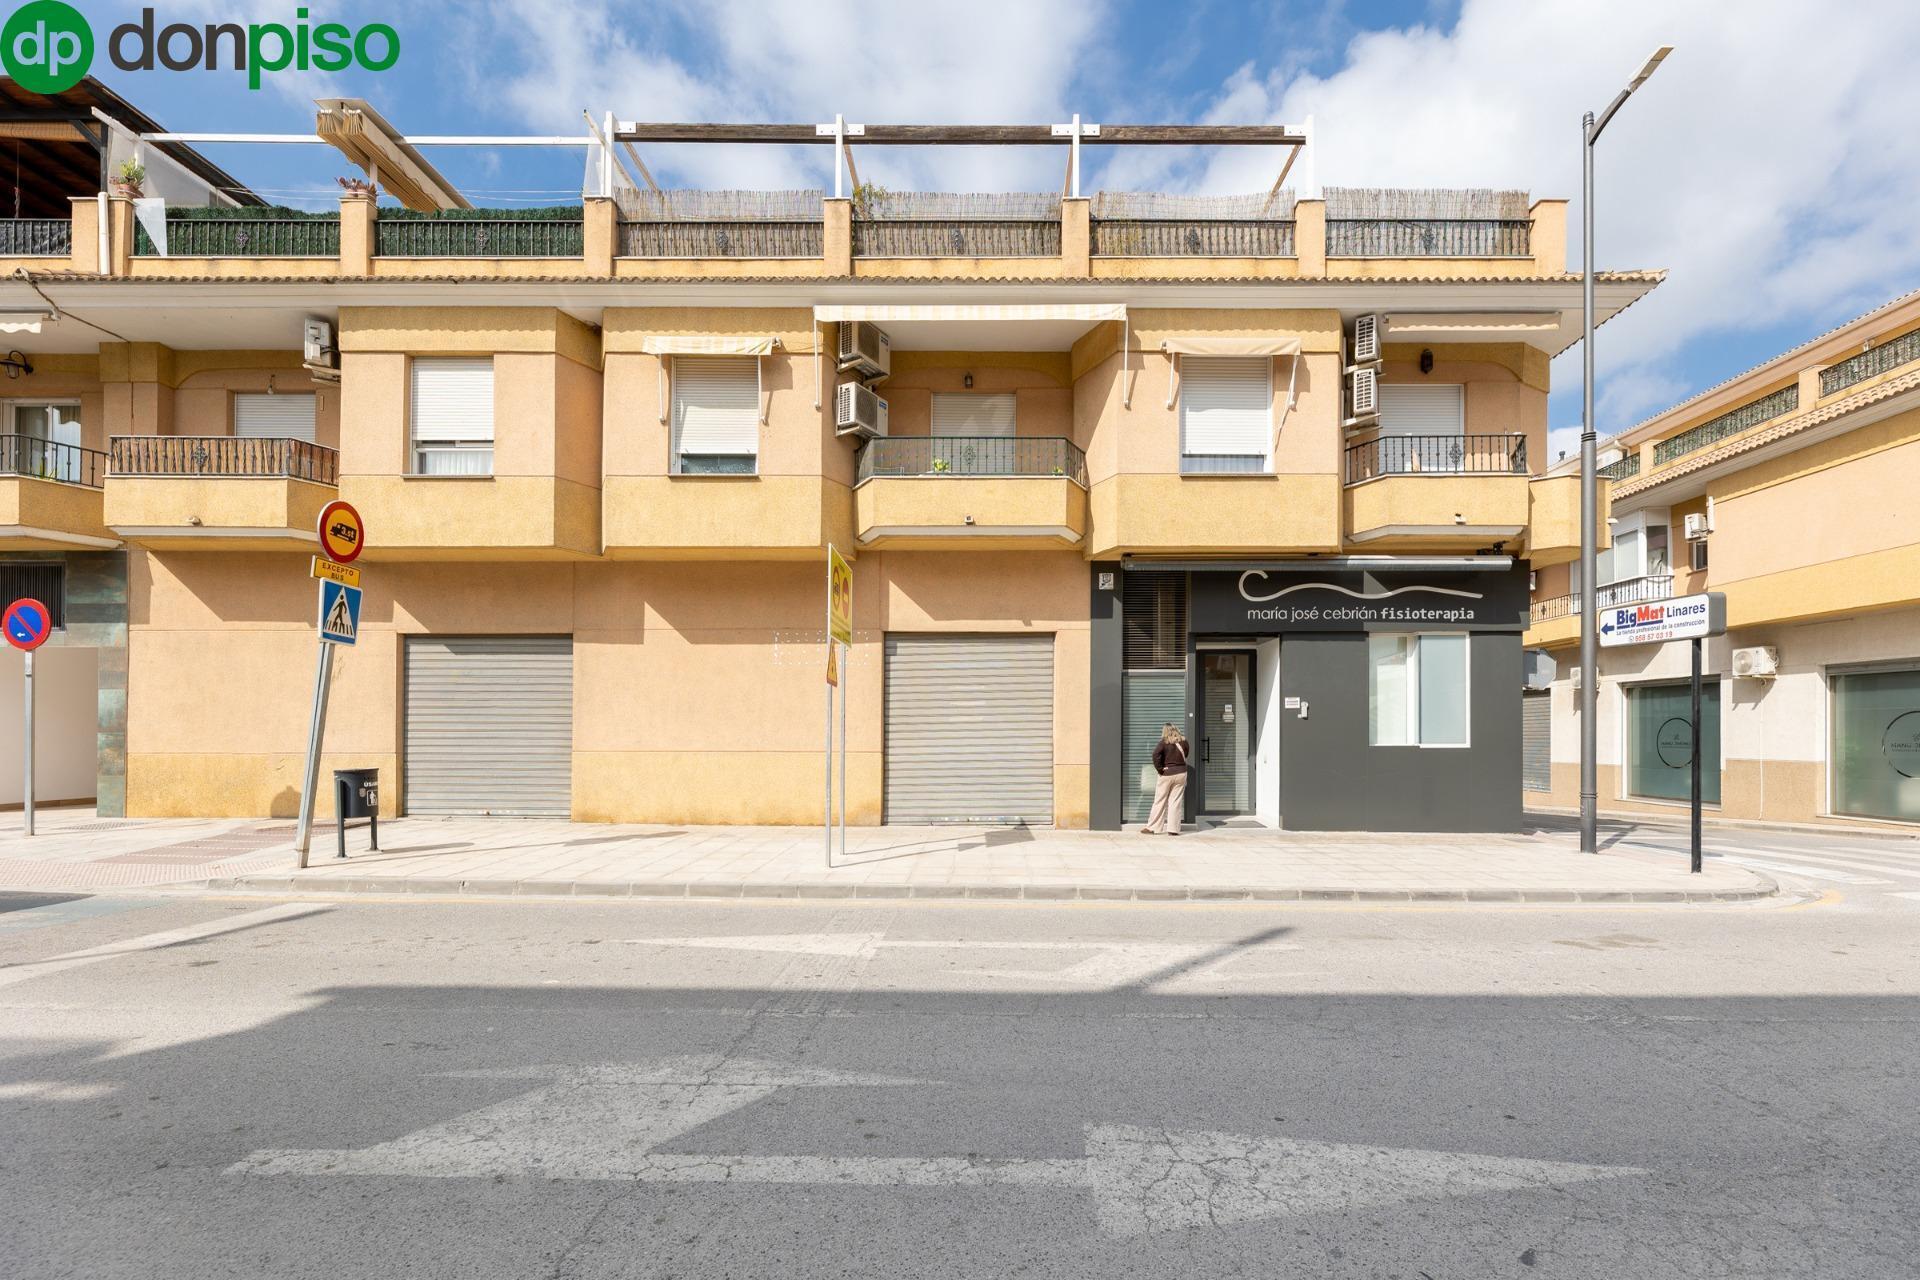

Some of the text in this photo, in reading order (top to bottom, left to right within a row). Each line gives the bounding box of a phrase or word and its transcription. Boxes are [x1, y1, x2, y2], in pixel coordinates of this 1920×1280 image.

[322, 562, 354, 577] EXCEPTO
[331, 573, 345, 582] BUS
[1247, 606, 1475, 623] maría josé cebrián fisioterapia
[1616, 603, 1706, 627] BigMat Linares
[1673, 619, 1706, 629] construcción
